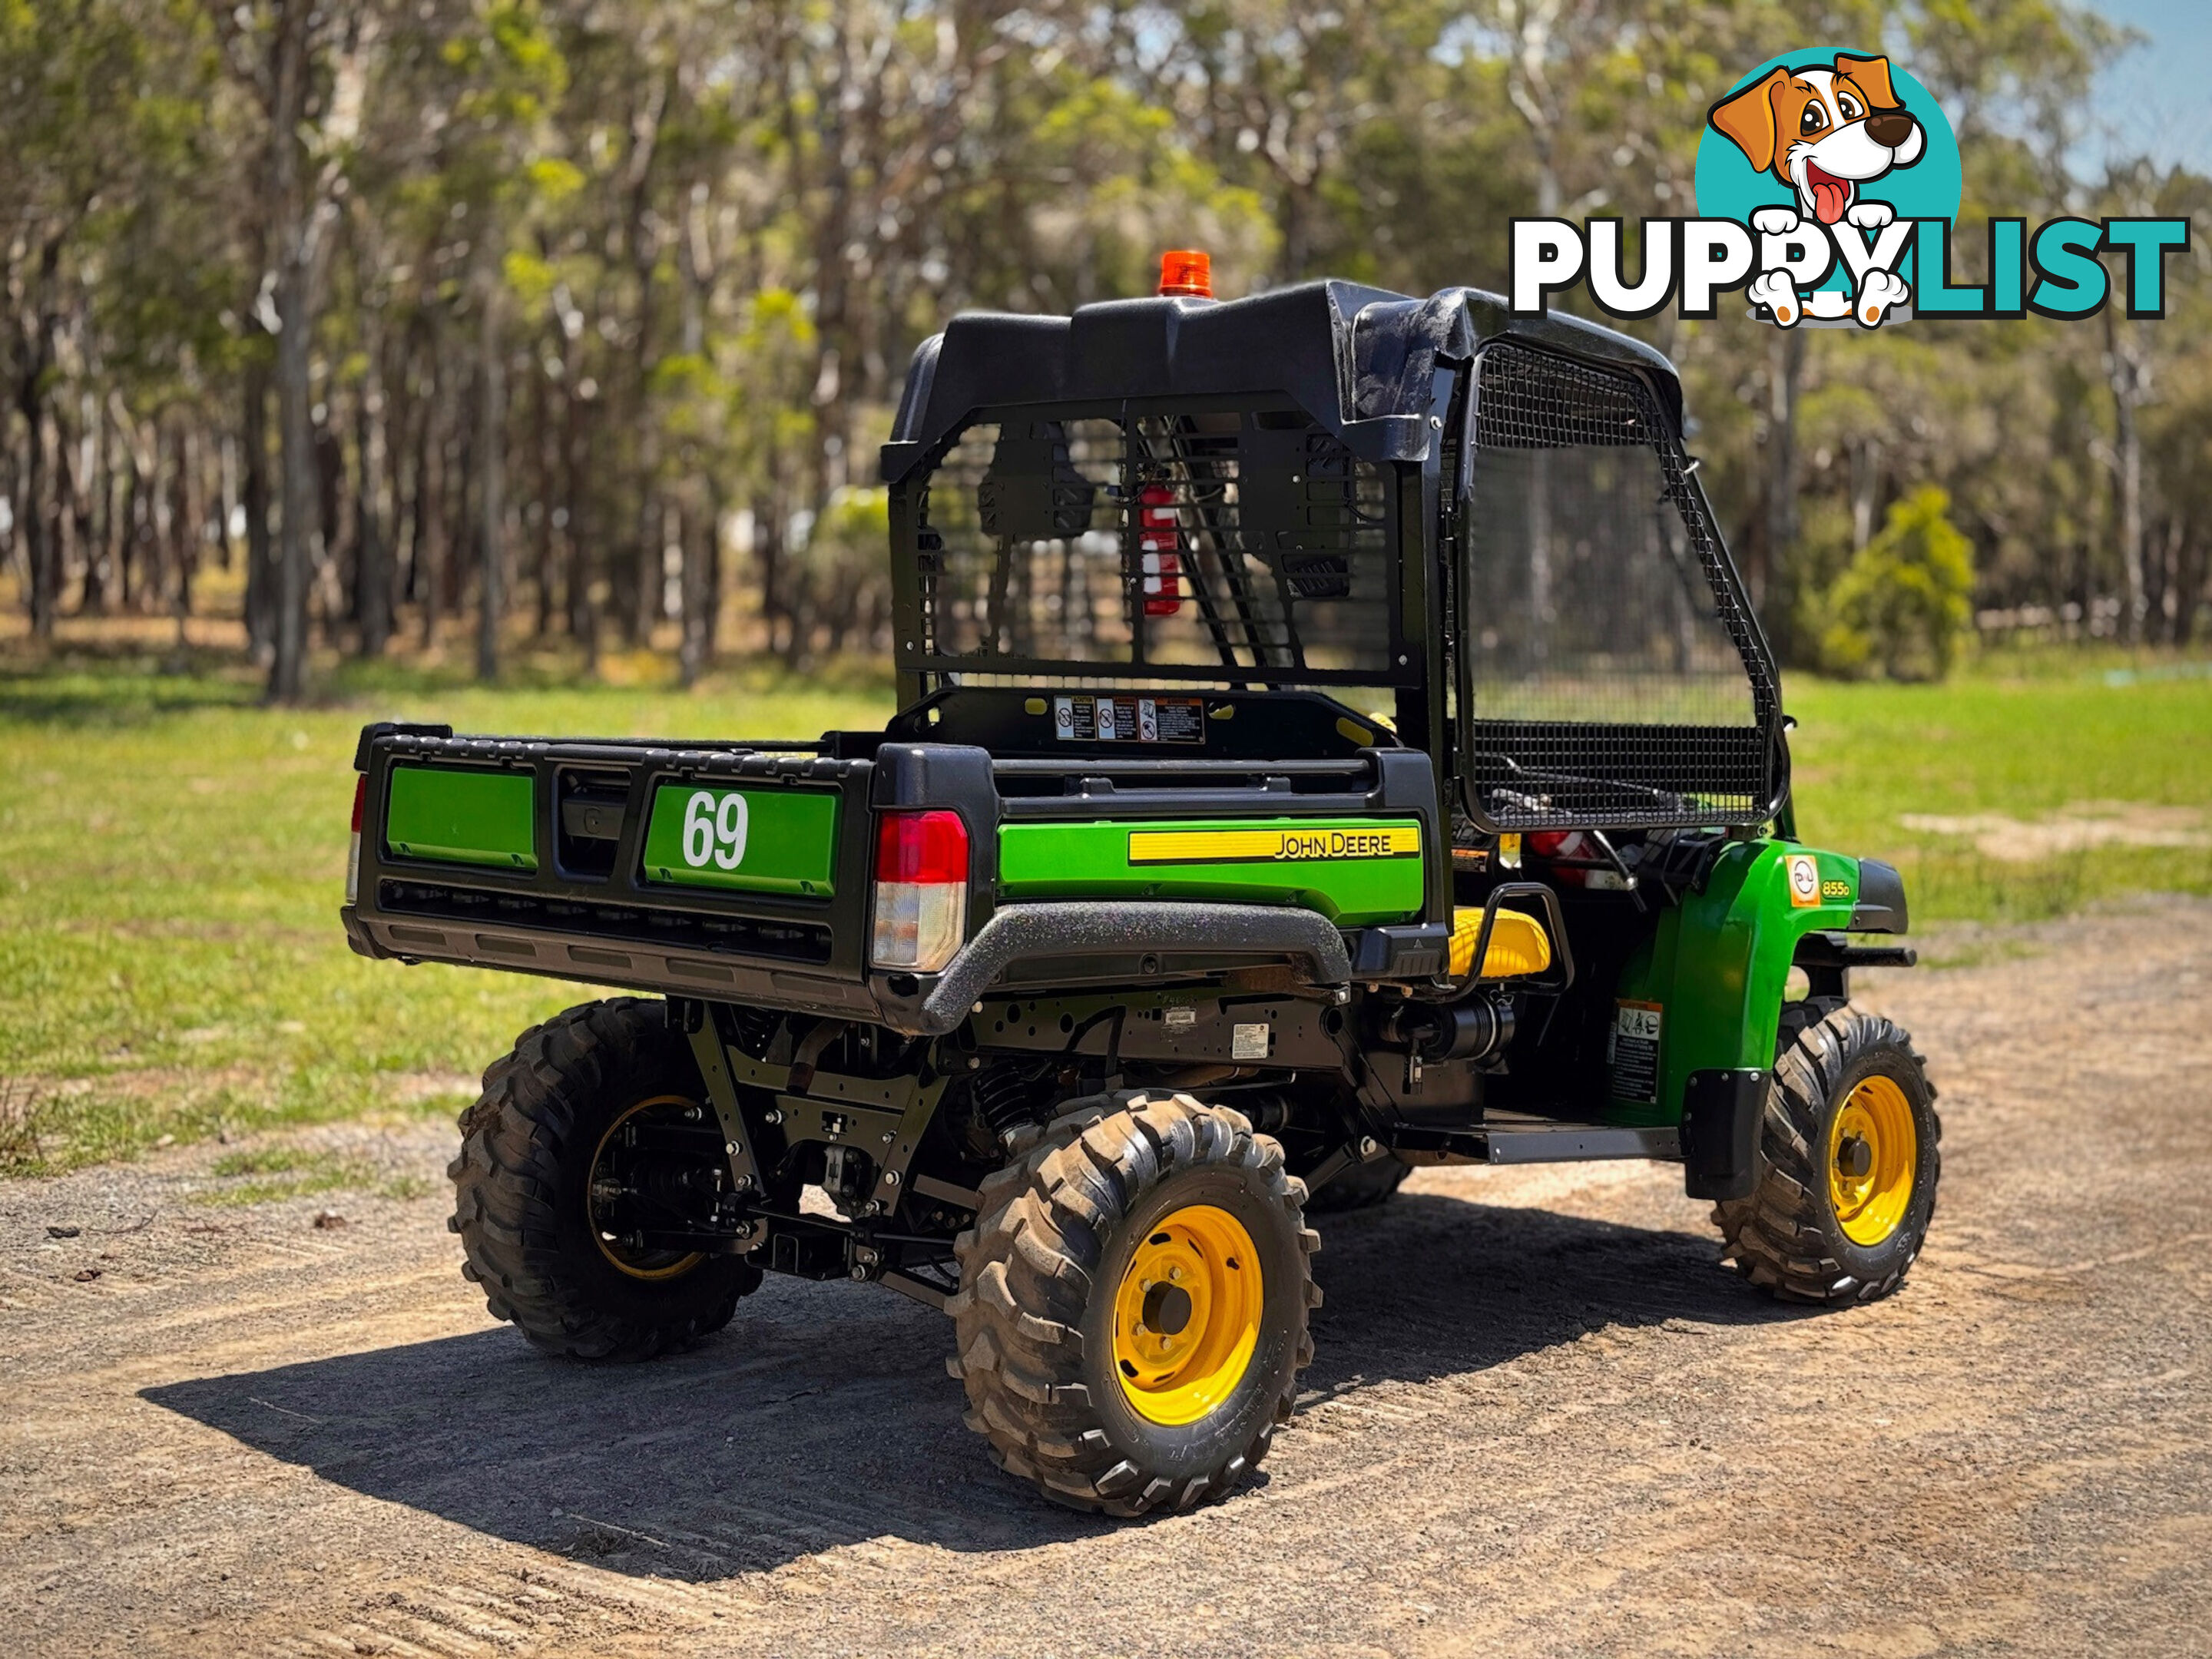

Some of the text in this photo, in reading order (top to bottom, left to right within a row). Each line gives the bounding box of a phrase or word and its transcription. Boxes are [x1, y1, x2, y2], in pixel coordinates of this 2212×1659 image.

[683, 791, 748, 869] 69
[1275, 833, 1392, 857] JOHN DEERE
[1823, 880, 1850, 896] 855D
